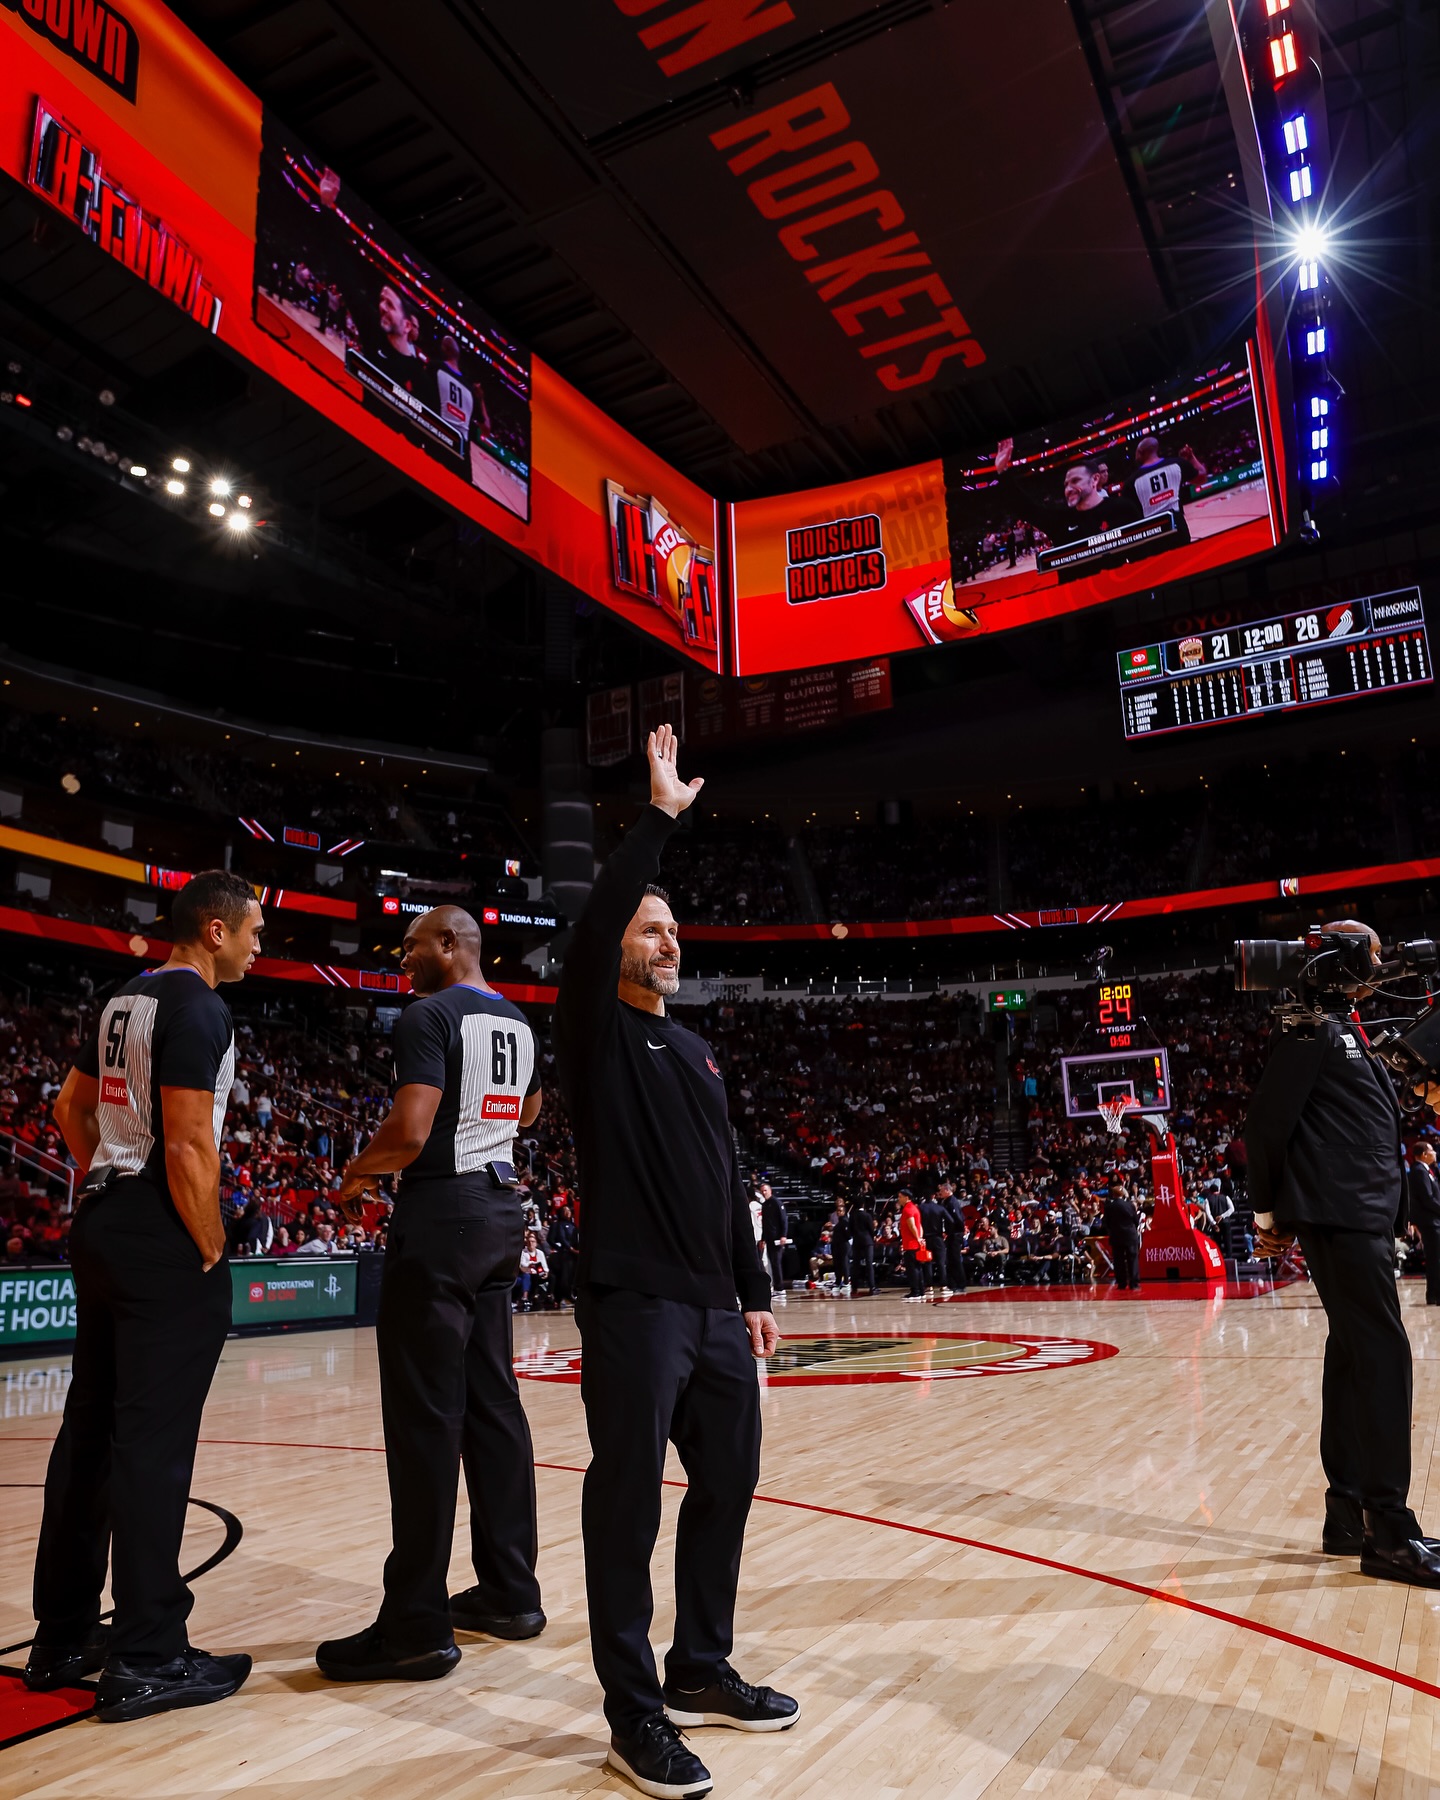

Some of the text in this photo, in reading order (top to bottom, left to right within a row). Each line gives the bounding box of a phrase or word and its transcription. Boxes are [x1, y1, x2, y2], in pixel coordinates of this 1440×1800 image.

[708, 81, 987, 391] ROCKETS
[449, 381, 463, 409] 61
[1150, 472, 1169, 494] 61
[790, 517, 876, 560] HOUSTON
[1087, 533, 1105, 547] JASON
[790, 553, 881, 600] ROCKETS
[1244, 623, 1283, 648] 12:00
[1295, 614, 1320, 642] 26
[1211, 633, 1230, 660] 21
[789, 669, 834, 687] HAKEEM
[1125, 664, 1157, 676] TOYOTATHON
[783, 681, 838, 700] OLAJUWON
[500, 913, 556, 927] TUNDRA ZONE
[1099, 984, 1131, 1000] 12:00
[1098, 999, 1131, 1024] 24
[1106, 1024, 1137, 1033] TISSOT
[491, 1030, 517, 1086] 61
[486, 1100, 517, 1114] Emirates
[1146, 1246, 1194, 1257] MEMORIAL
[1146, 1252, 1196, 1262] HERMANN
[0, 1278, 76, 1303] FFICIA
[267, 1280, 314, 1290] TOYOTATHON
[267, 1290, 276, 1301] IS
[11, 1305, 77, 1331] HOUS
